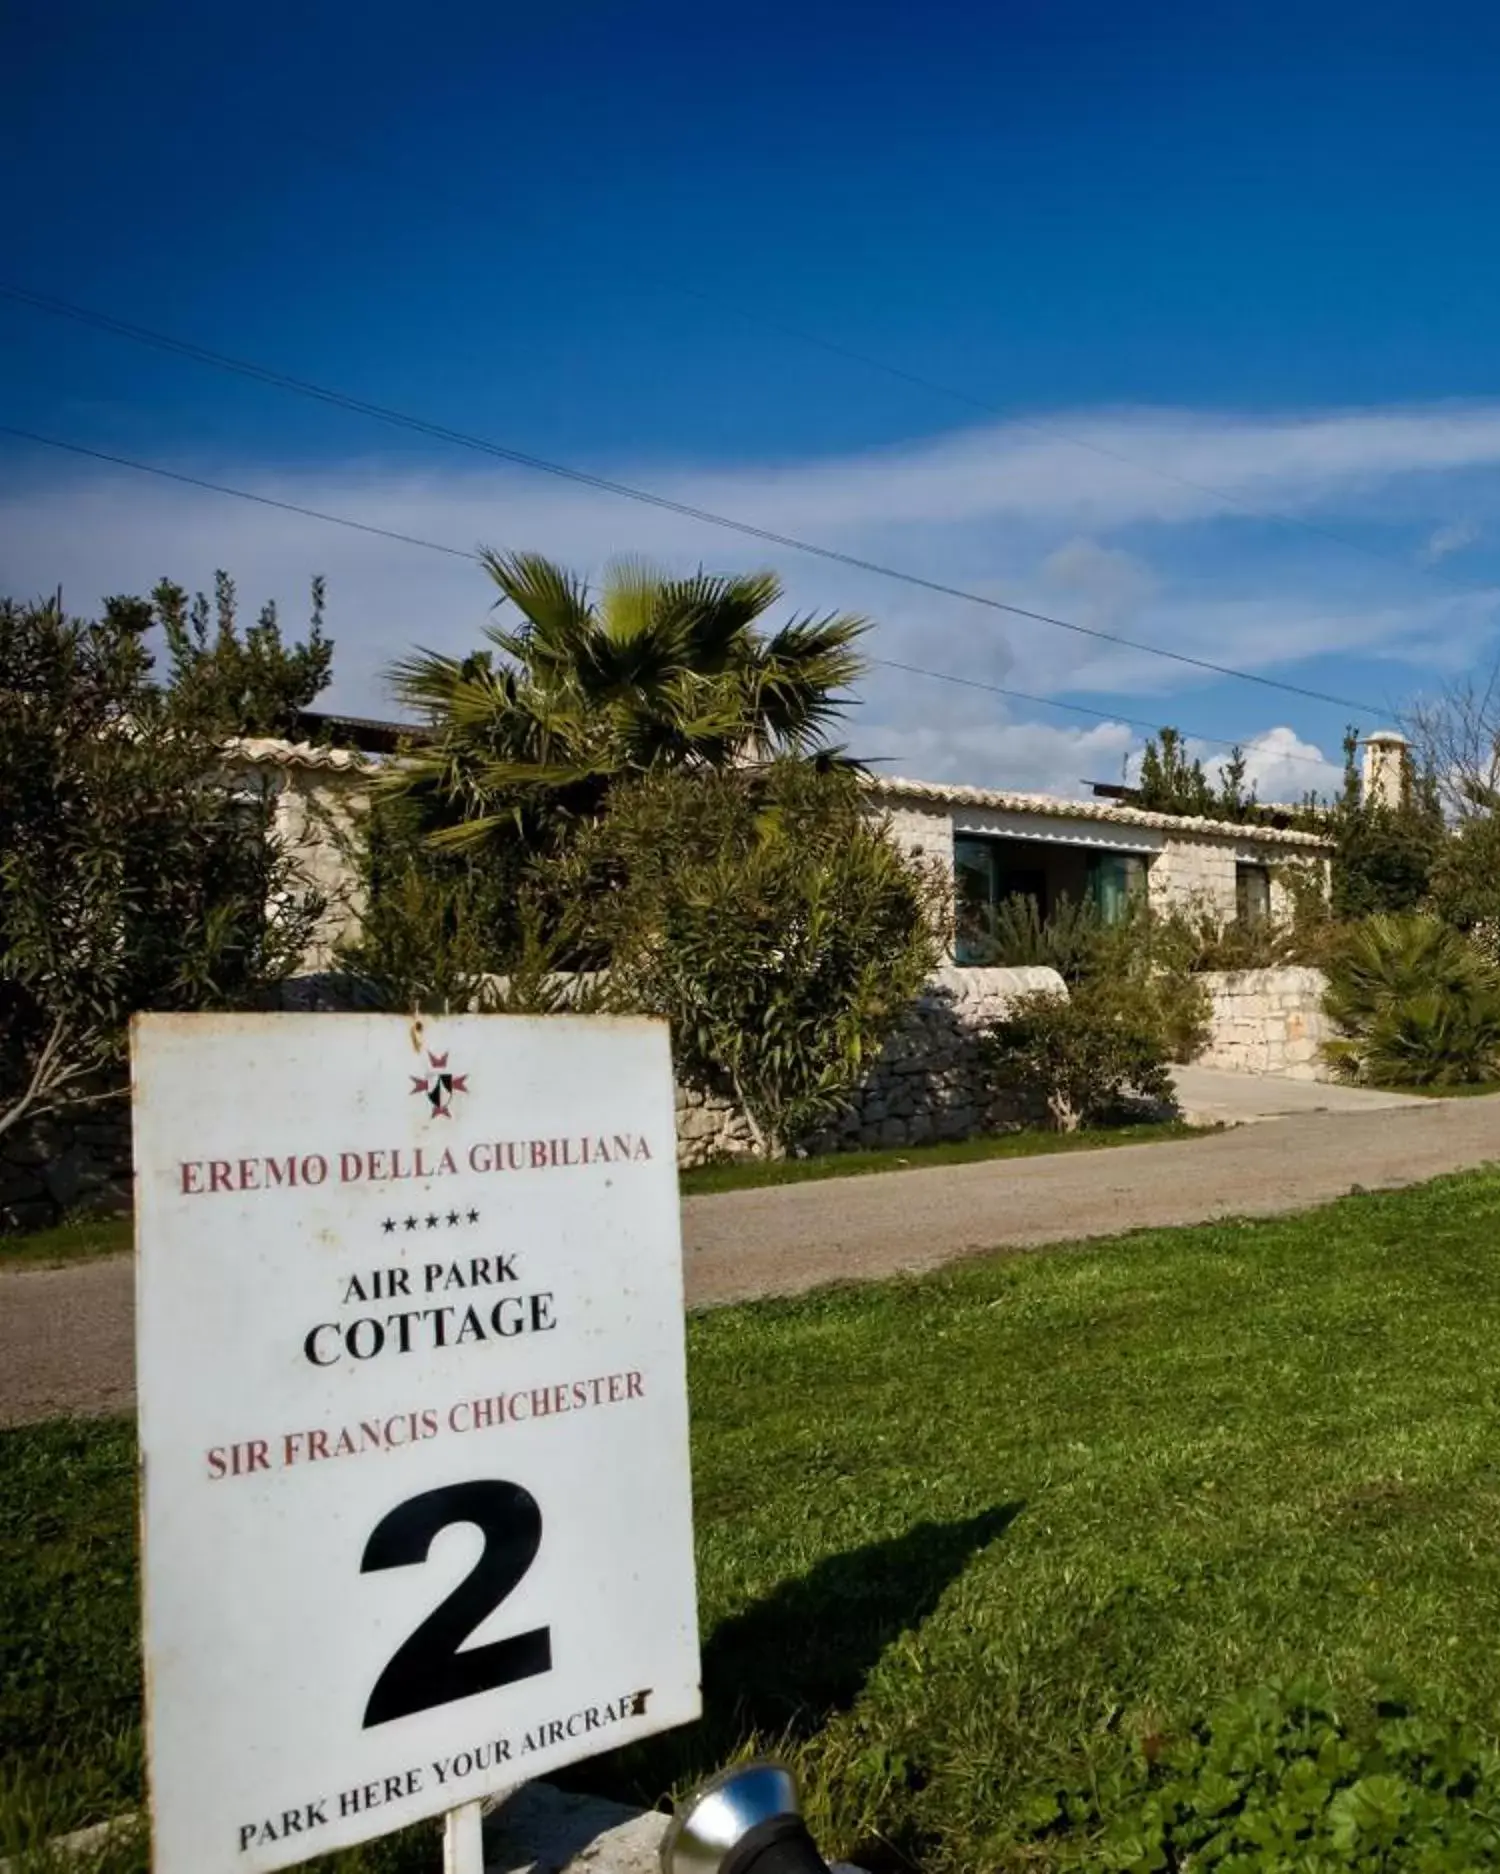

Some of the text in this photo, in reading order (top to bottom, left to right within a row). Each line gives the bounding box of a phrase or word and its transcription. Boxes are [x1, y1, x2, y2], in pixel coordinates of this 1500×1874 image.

[178, 1133, 653, 1197] EREMO DELLA GIUBILIANA
[341, 1253, 521, 1305] AIR PARK
[303, 1291, 558, 1368] COTTAGE
[206, 1370, 646, 1481] SIR FRANCIS CHICHESTER
[359, 1478, 554, 1731] 2
[237, 1802, 330, 1853] PARK
[338, 1766, 423, 1819] HERE
[431, 1738, 513, 1786] YOUR
